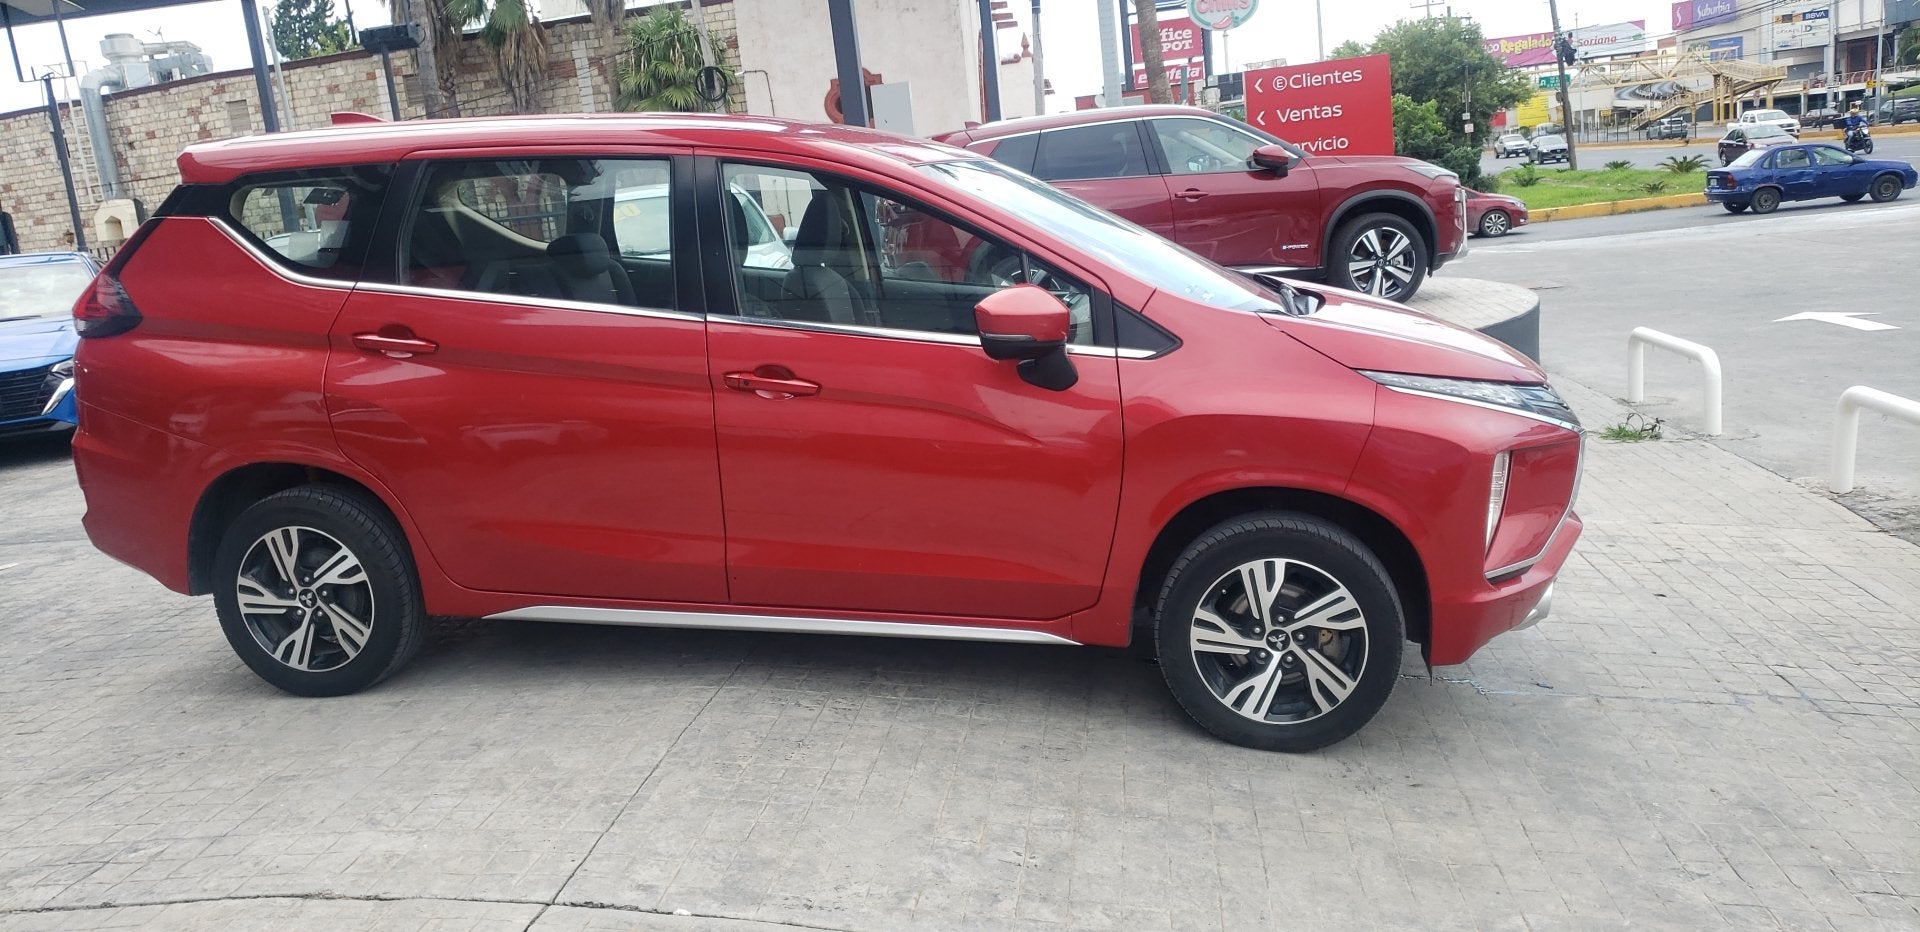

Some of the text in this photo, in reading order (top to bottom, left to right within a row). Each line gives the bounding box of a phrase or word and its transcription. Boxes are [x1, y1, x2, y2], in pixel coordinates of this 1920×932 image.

[1196, 0, 1250, 14] Chilis
[1697, 0, 1730, 20] Suburbia
[1805, 11, 1826, 20] BBVA
[1159, 27, 1193, 42] fice
[1578, 36, 1617, 47] Soriana
[1161, 39, 1194, 53] POT
[1500, 34, 1552, 54] Regalado
[1289, 69, 1363, 89] Clientes
[1276, 104, 1343, 123] Ventas
[1292, 135, 1349, 152] rvicio
